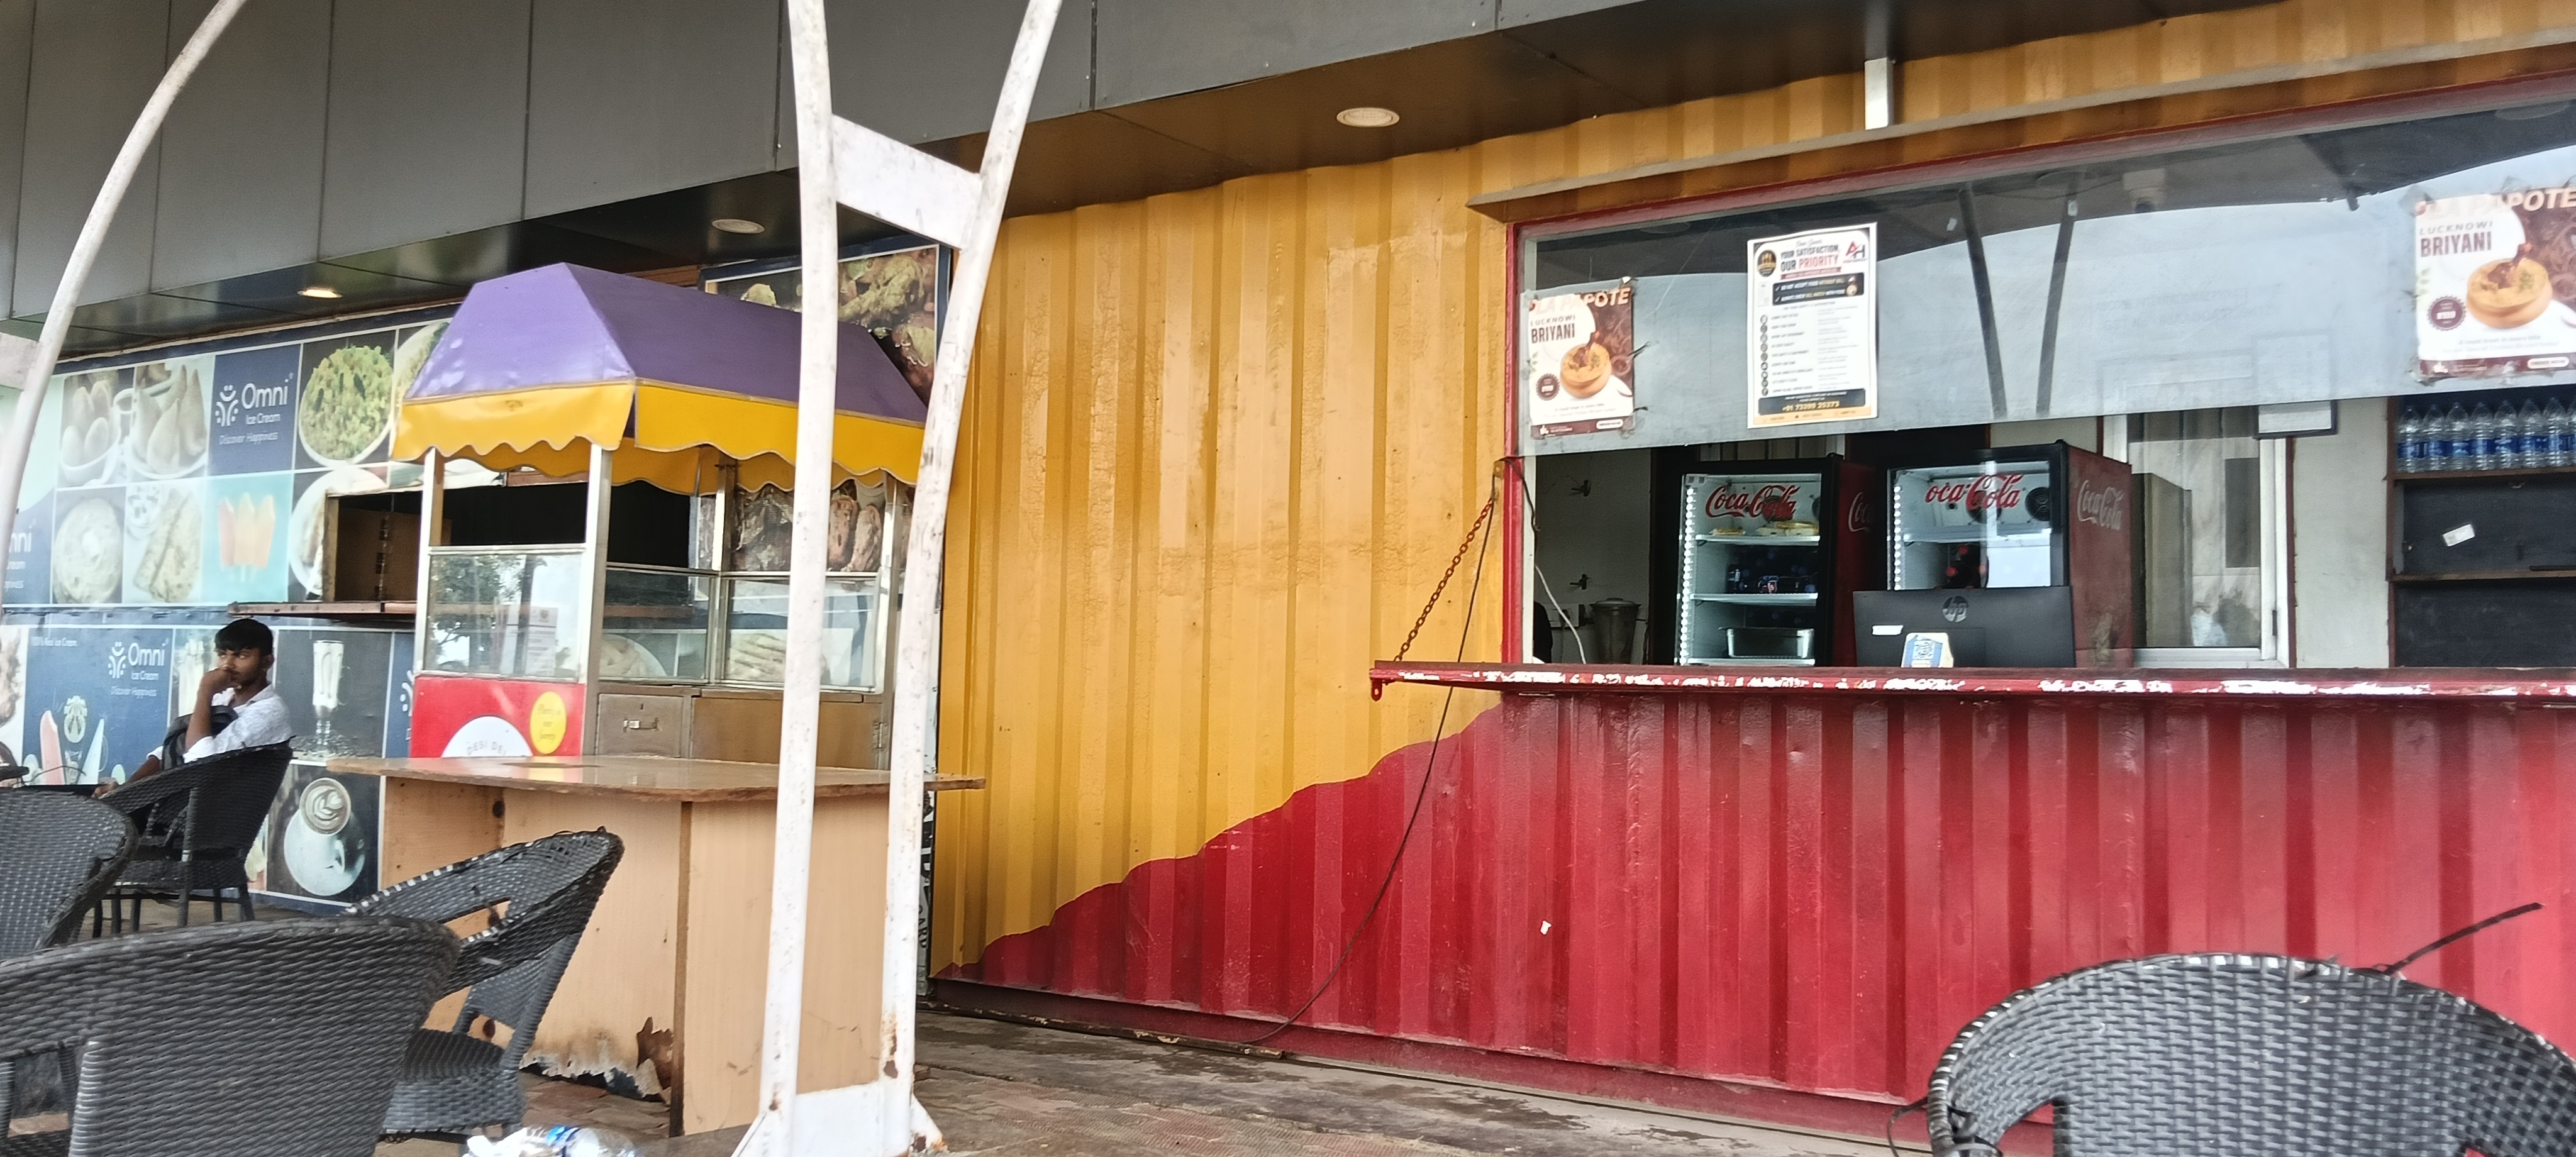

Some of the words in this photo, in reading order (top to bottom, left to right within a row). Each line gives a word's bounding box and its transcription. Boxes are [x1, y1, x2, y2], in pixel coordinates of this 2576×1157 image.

[2419, 220, 2493, 235] LUCKNOWI
[2421, 231, 2492, 257] BRIYANI
[1781, 260, 1797, 272] OUR
[1799, 254, 1839, 269] PRIORITY
[1530, 315, 1575, 326] LUCKNOWI
[1531, 323, 1575, 344] BRIYANI
[242, 379, 288, 409] Omni
[246, 414, 256, 424] Ice
[257, 412, 280, 423] Cream
[9, 524, 32, 553] mni
[1943, 595, 1968, 623] hp
[128, 642, 165, 666] Omni
[140, 670, 158, 680] Cream
[467, 740, 488, 756] DESI
